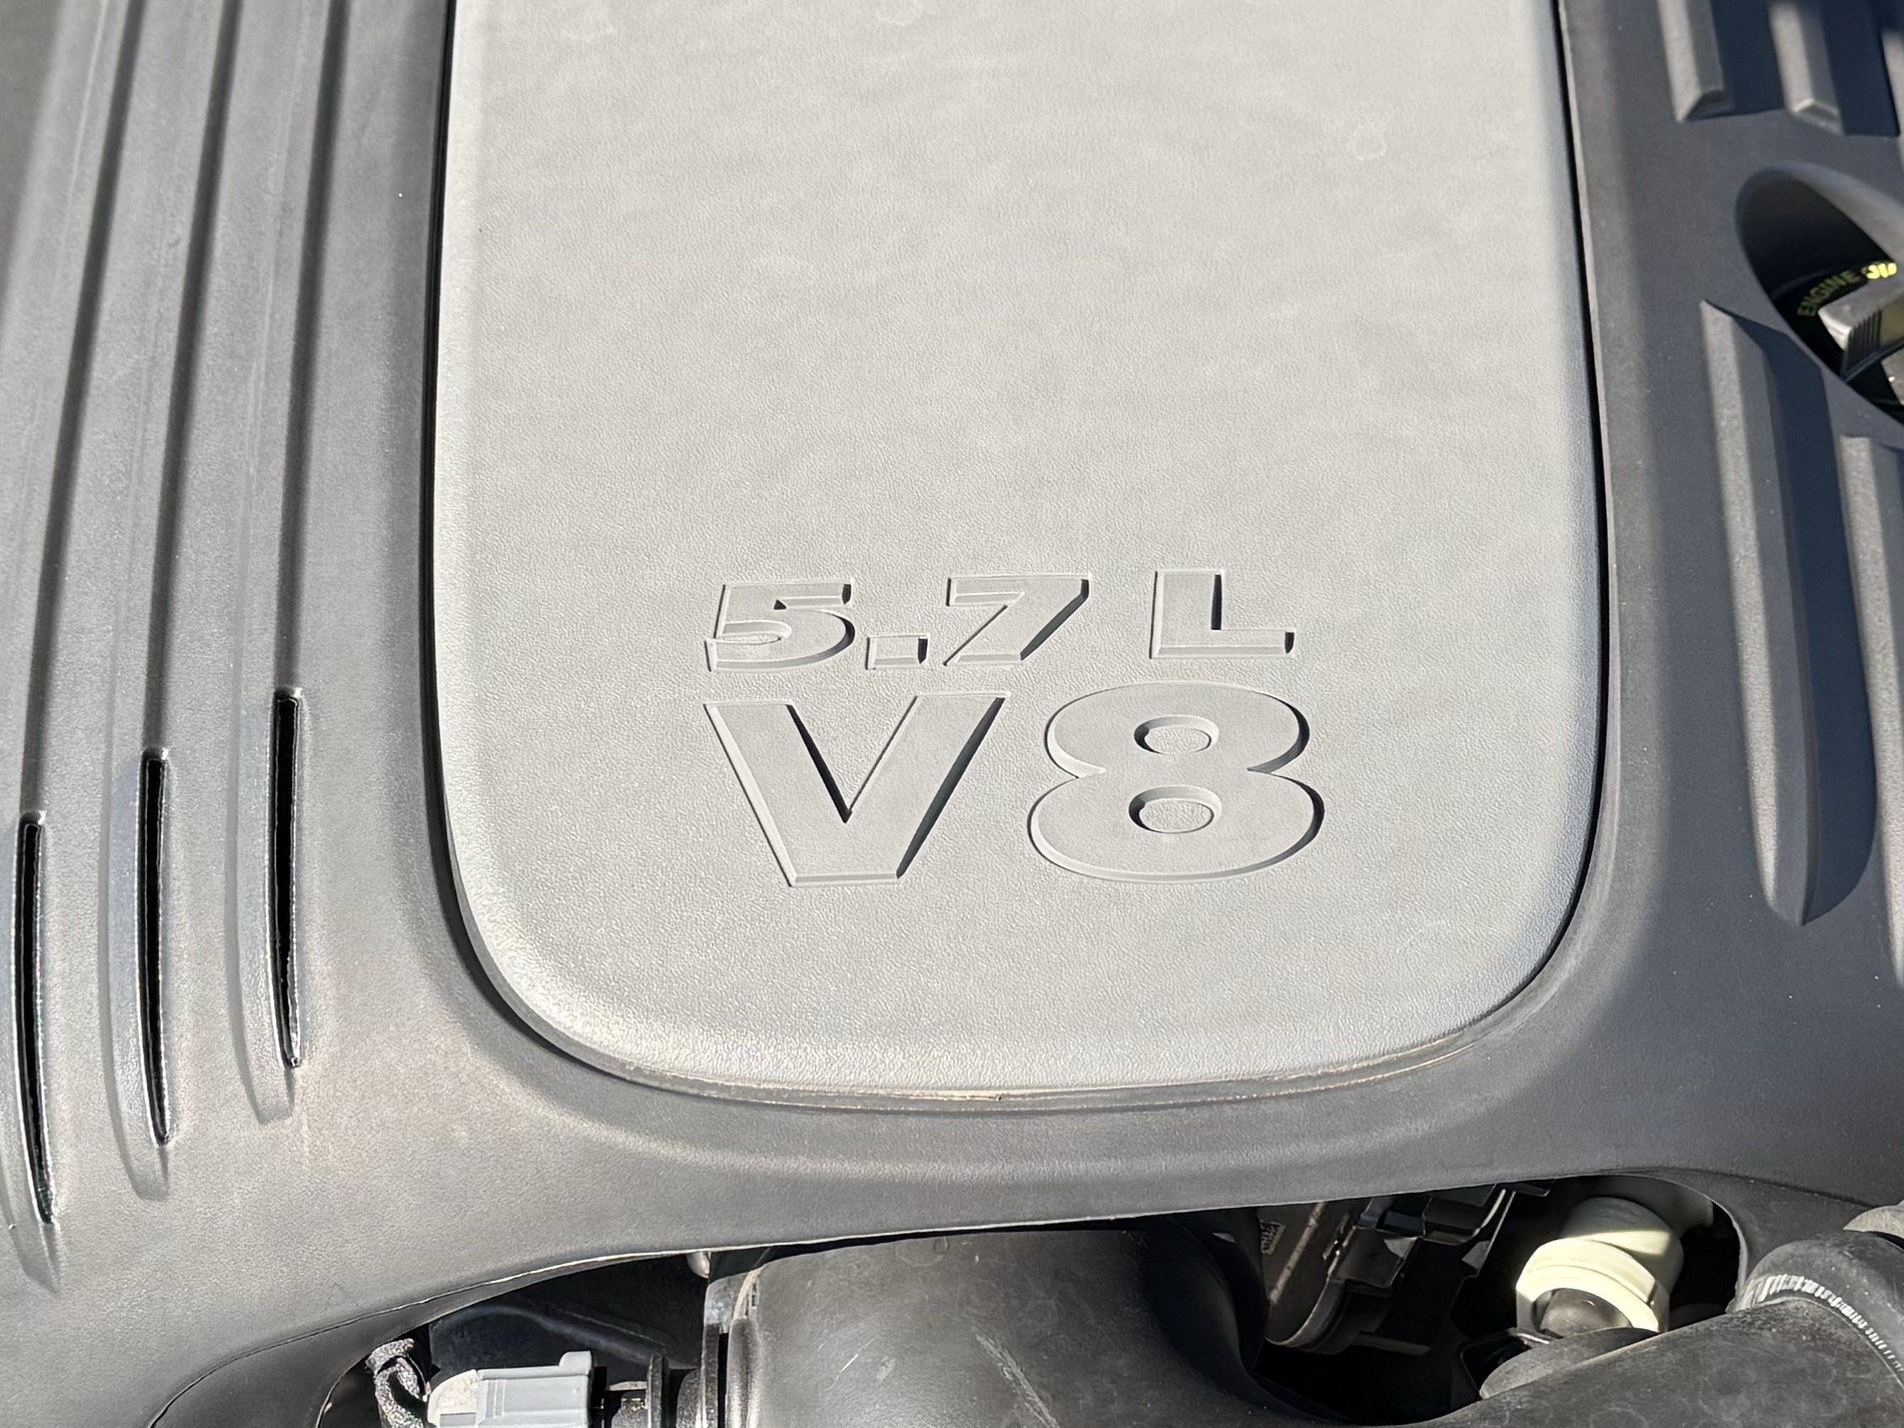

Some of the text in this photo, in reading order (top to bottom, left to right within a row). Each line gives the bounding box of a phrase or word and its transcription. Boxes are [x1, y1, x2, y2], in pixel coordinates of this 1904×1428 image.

[1797, 269, 1863, 318] ENGINE
[704, 568, 1297, 672] 5.7 L
[702, 680, 1325, 887] V8
